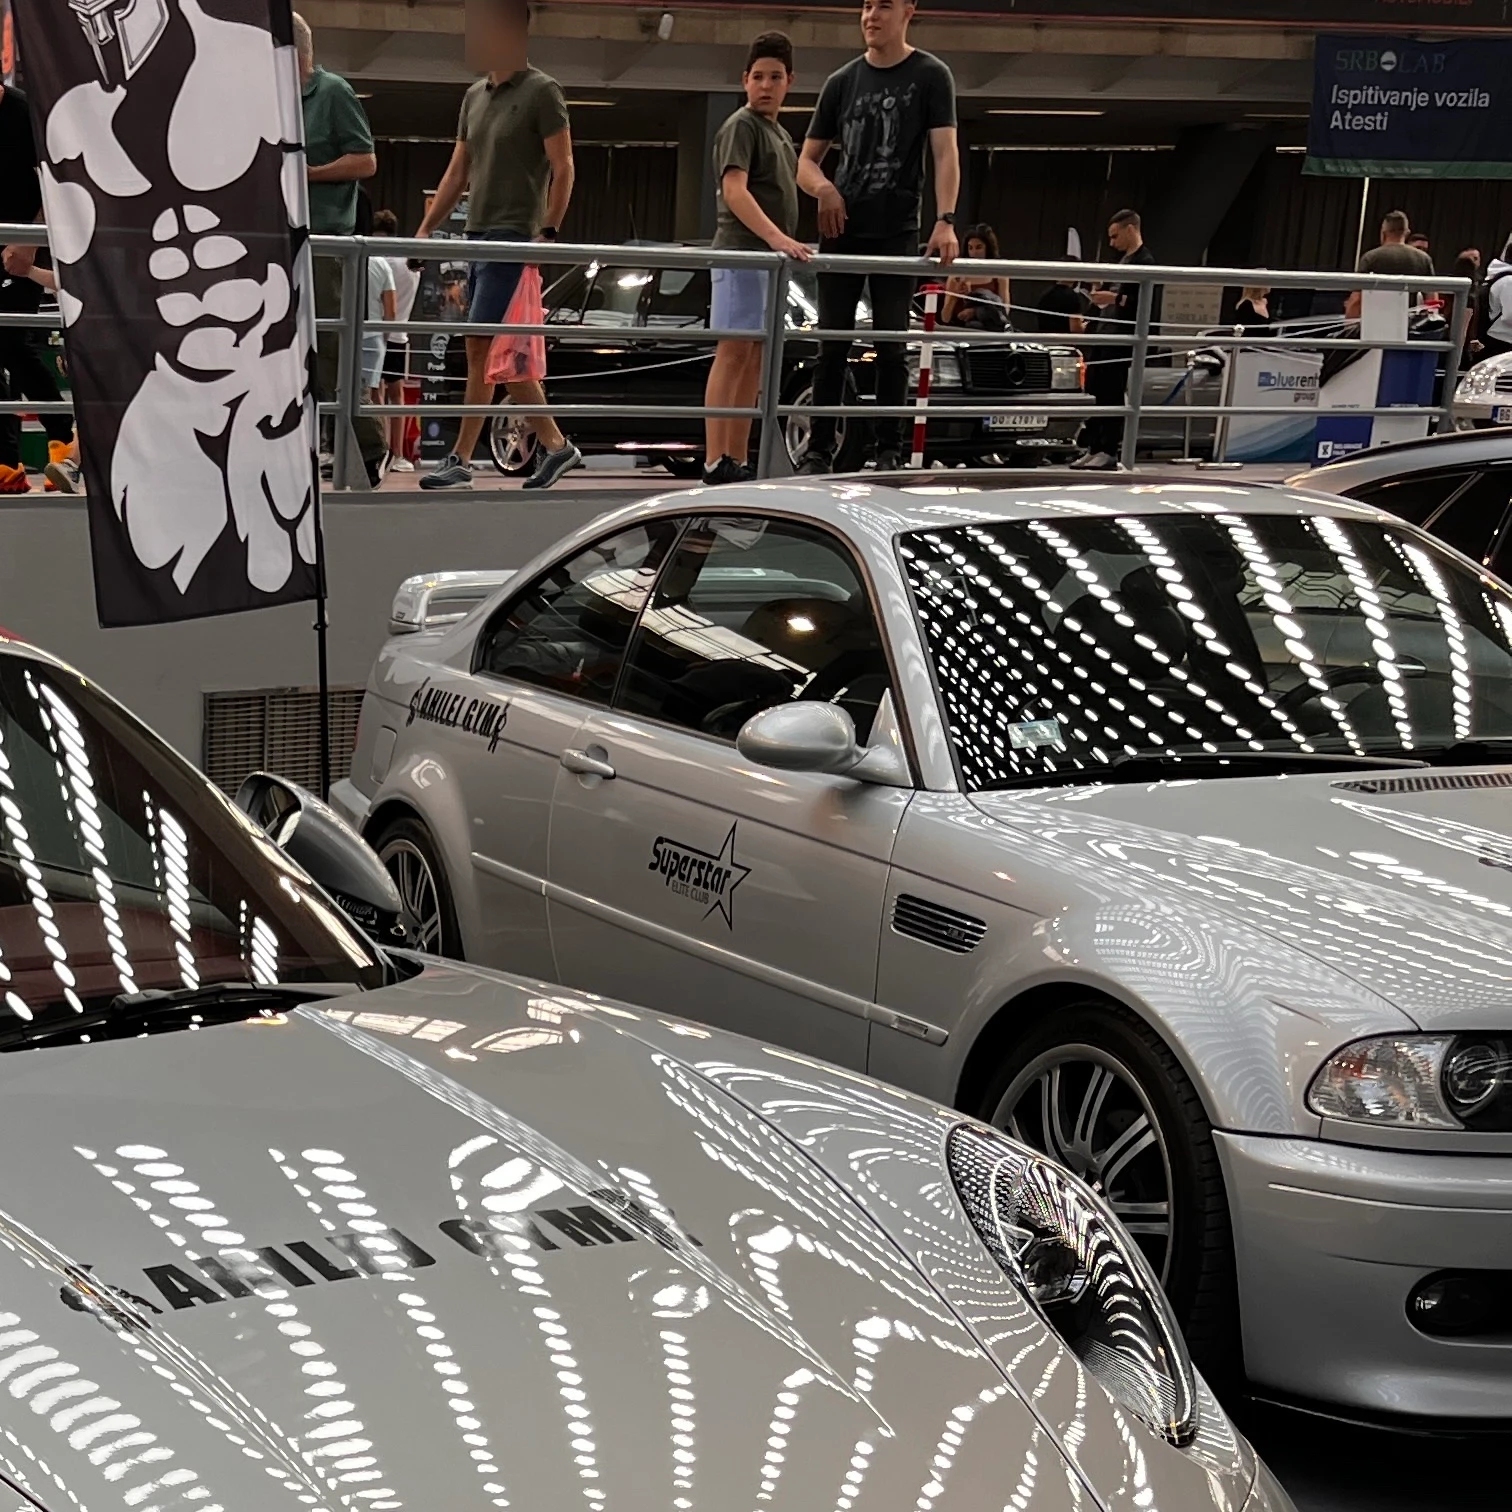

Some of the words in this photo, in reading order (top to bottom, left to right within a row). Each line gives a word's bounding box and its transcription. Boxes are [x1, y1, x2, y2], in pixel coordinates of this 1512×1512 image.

[1331, 84, 1429, 111] Ispitivanje
[1434, 87, 1491, 107] vozila
[1329, 110, 1389, 131] Atesti
[462, 698, 501, 738] GYM
[648, 836, 732, 895] Superstar
[671, 879, 689, 898] ELITE
[690, 887, 710, 905] CLUB
